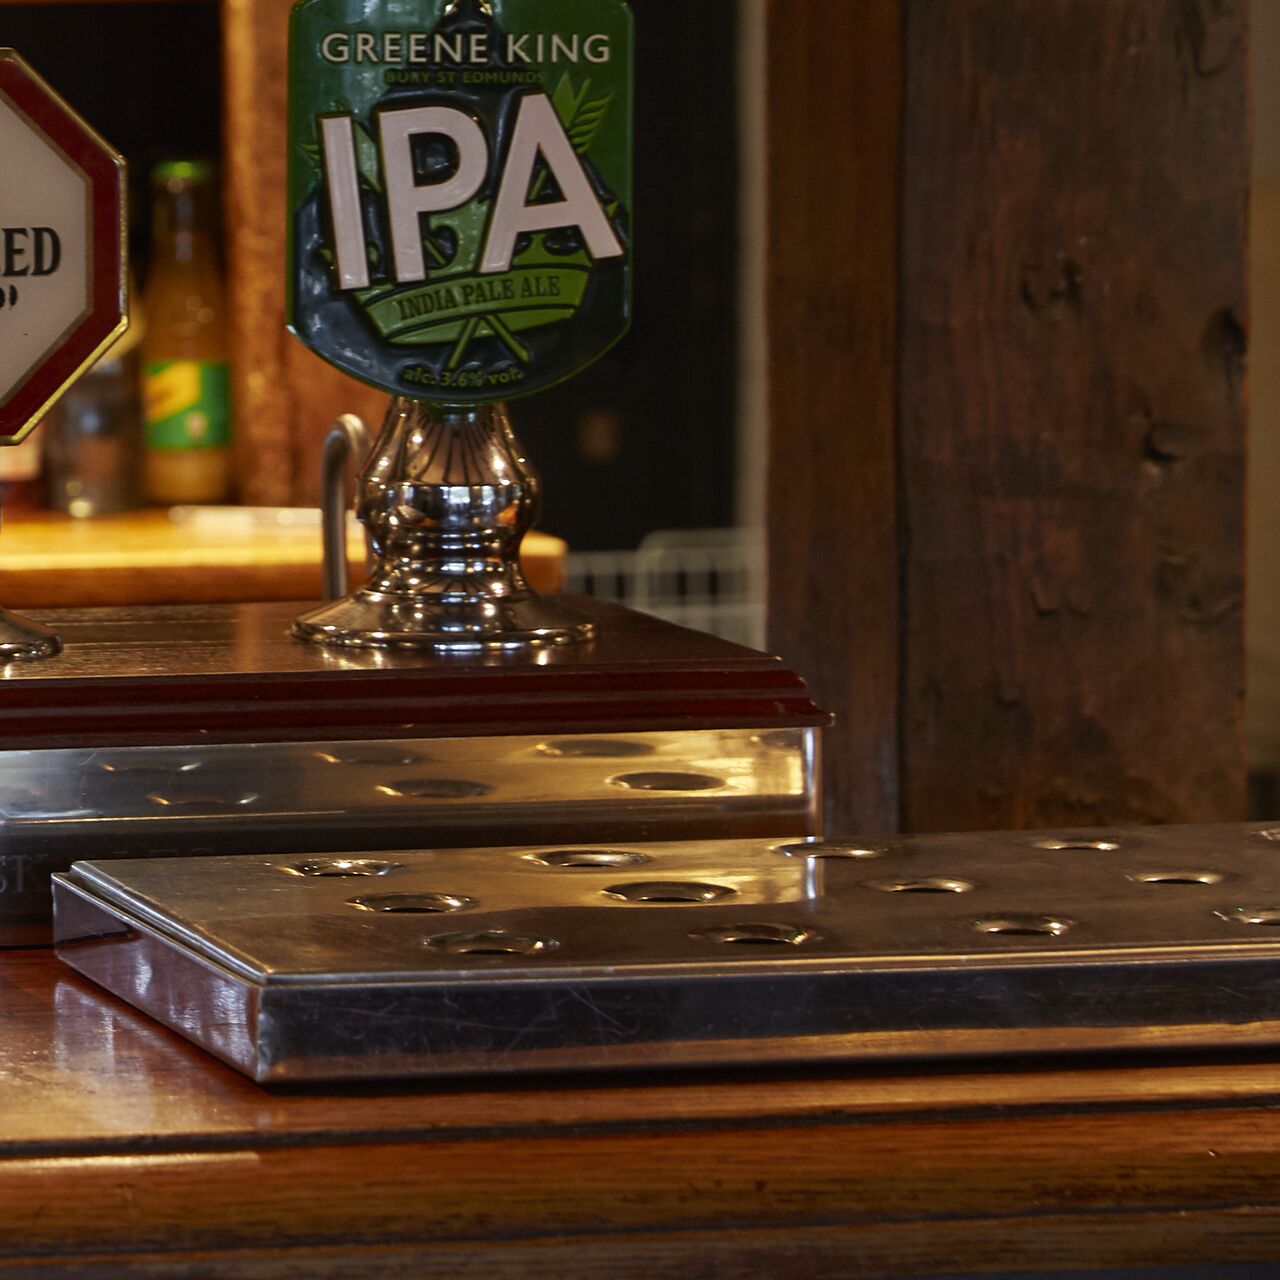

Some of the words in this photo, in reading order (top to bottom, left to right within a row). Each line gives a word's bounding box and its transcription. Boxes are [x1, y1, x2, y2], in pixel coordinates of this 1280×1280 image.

[321, 33, 488, 64] GREENE
[507, 33, 611, 64] KING
[386, 71, 429, 83] BURY
[437, 71, 455, 83] ST
[319, 93, 624, 291] IPA
[396, 287, 457, 320] INDIA
[460, 278, 515, 306] PALE
[521, 275, 560, 298] ALE
